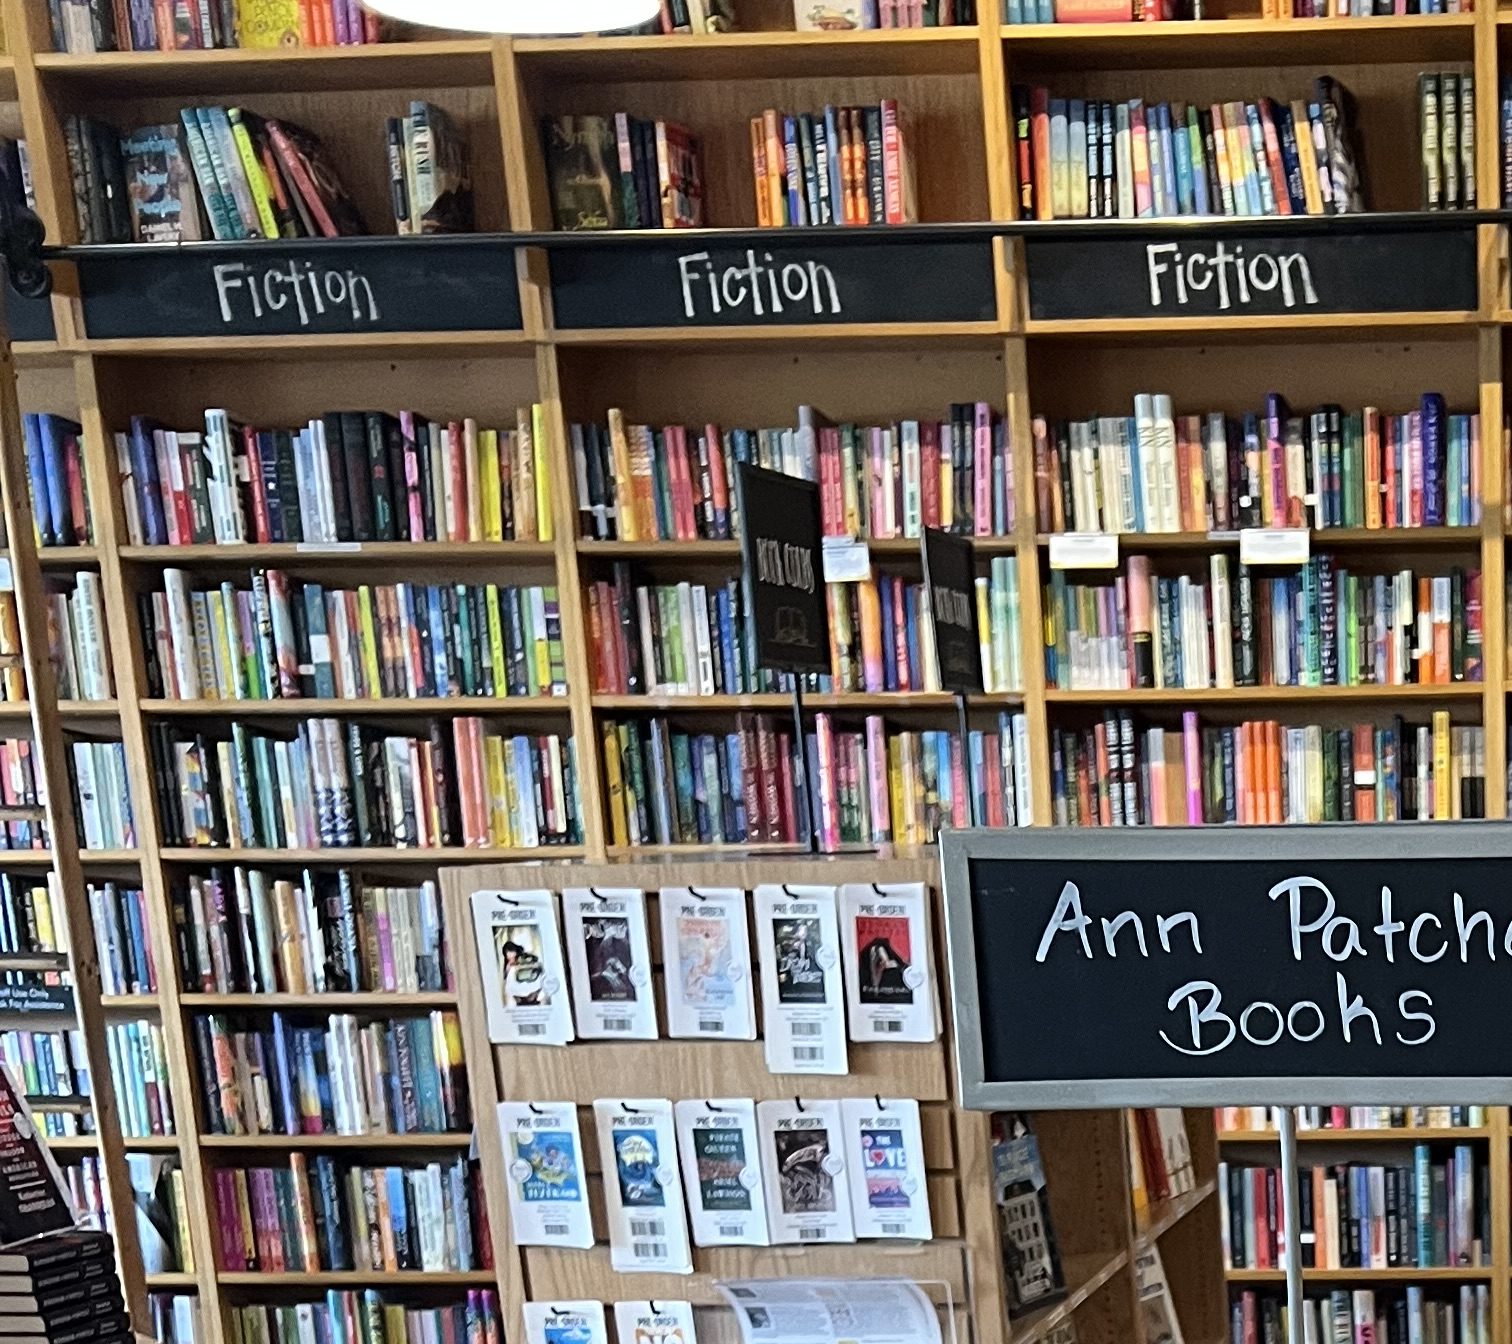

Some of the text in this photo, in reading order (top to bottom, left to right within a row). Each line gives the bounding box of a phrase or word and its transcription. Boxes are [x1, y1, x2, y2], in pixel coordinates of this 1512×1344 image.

[213, 260, 380, 324] Fiction
[678, 250, 841, 317] Fiction
[1148, 242, 1319, 309] Fiction
[1034, 880, 1203, 962] Ann
[1159, 972, 1437, 1056] Books
